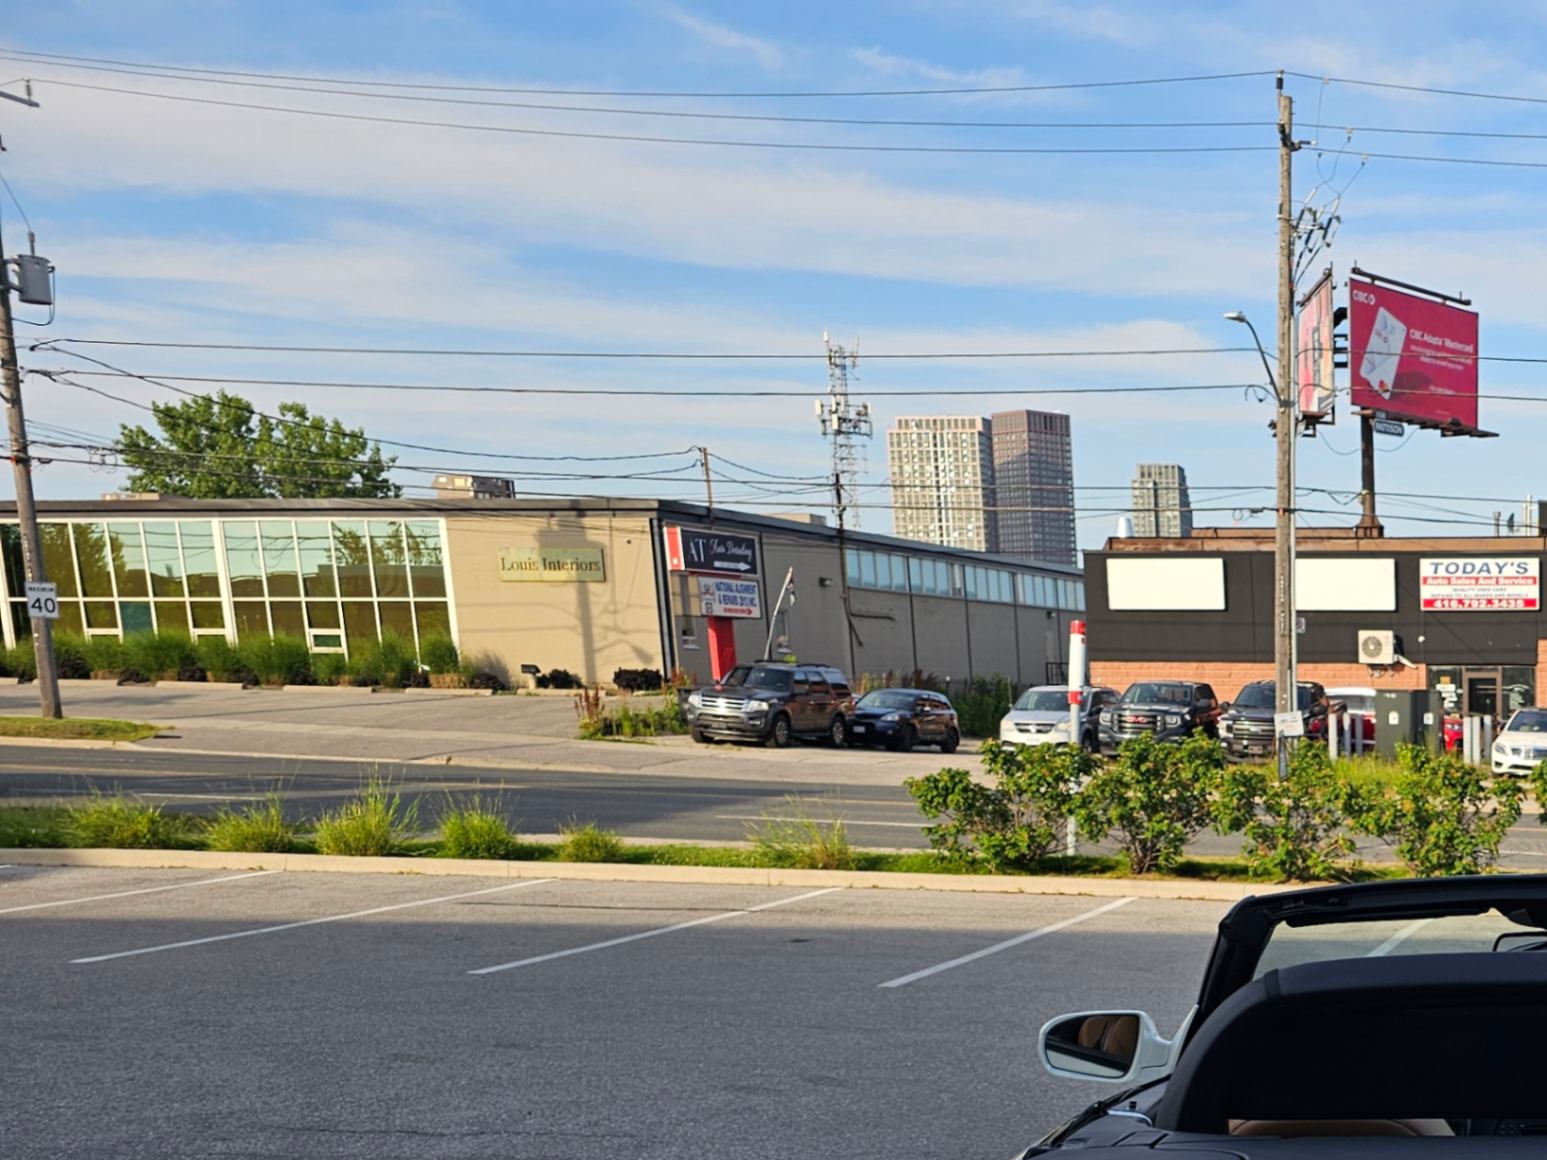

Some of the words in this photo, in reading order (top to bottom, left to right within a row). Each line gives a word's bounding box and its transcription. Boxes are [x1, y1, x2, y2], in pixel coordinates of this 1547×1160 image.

[501, 557, 539, 571] Louis
[542, 557, 601, 571] Interiors
[1430, 562, 1529, 575] TODAY'S
[1426, 577, 1448, 585] Auto
[1451, 577, 1476, 585] Sales
[1477, 577, 1497, 585] And
[1499, 577, 1533, 585] Service
[31, 598, 56, 613] 40
